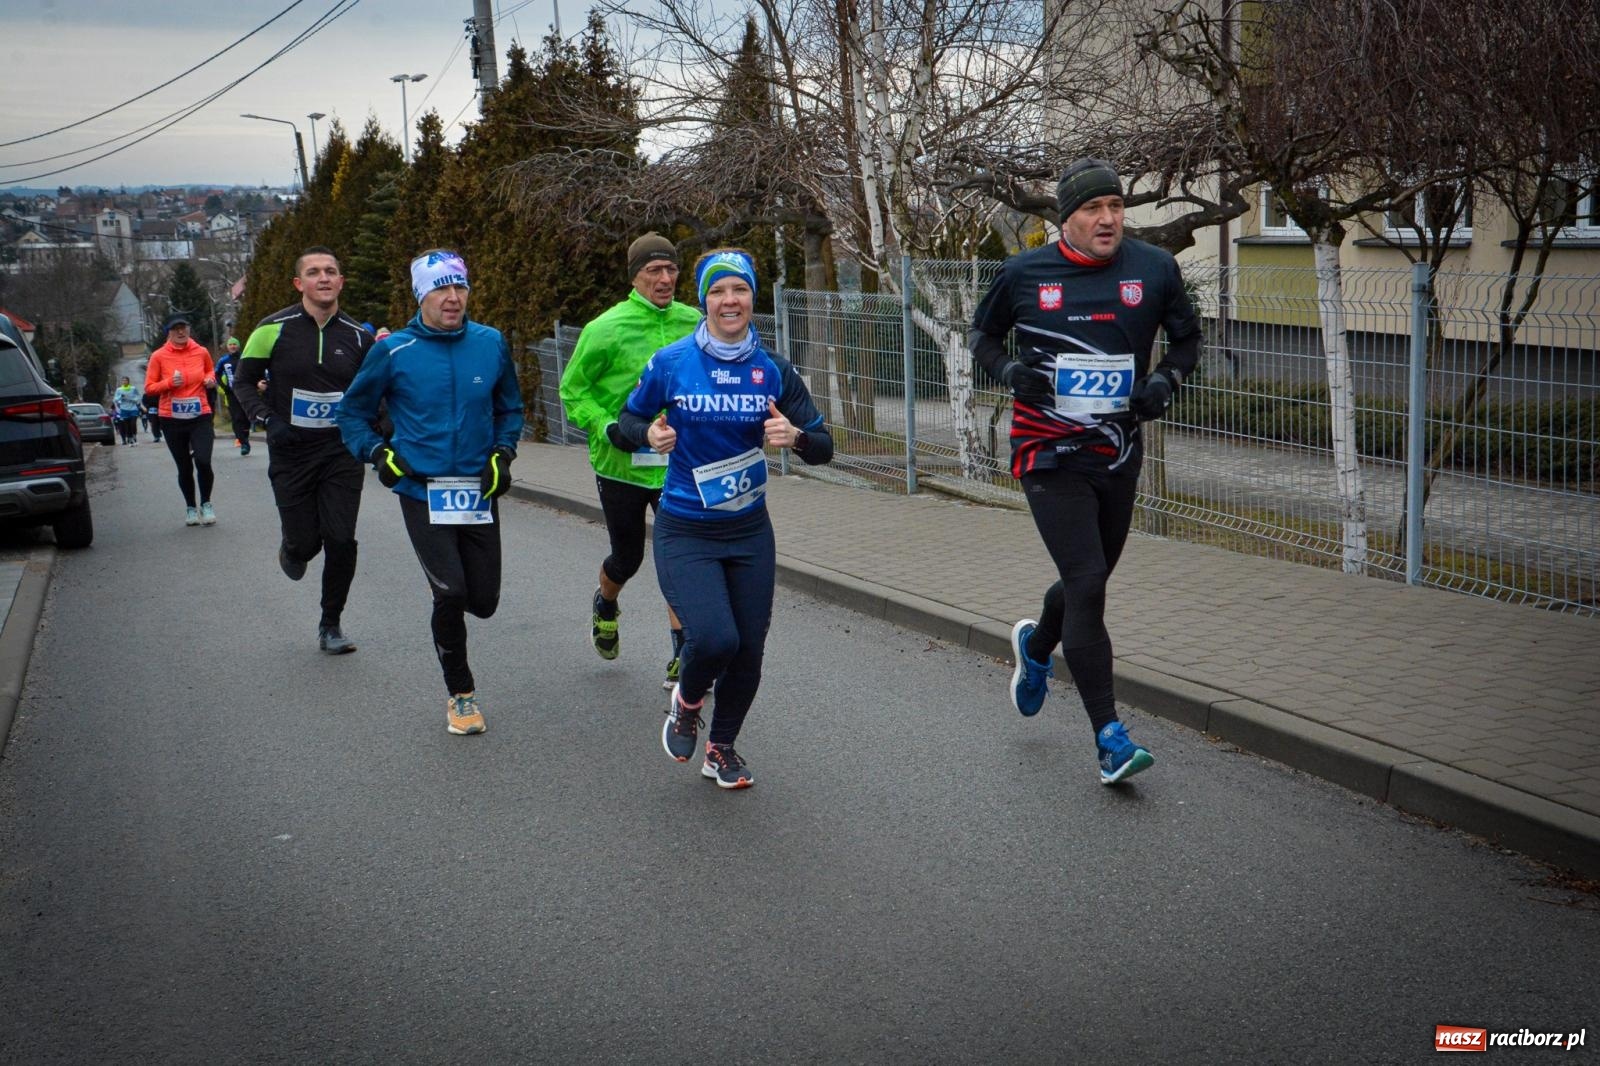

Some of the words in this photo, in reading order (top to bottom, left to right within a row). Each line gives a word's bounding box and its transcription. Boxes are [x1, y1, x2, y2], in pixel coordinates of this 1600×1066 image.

[1069, 370, 1123, 396] 229
[176, 403, 197, 413] 172
[306, 402, 332, 418] 69
[720, 469, 752, 499] 36
[441, 490, 482, 510] 107
